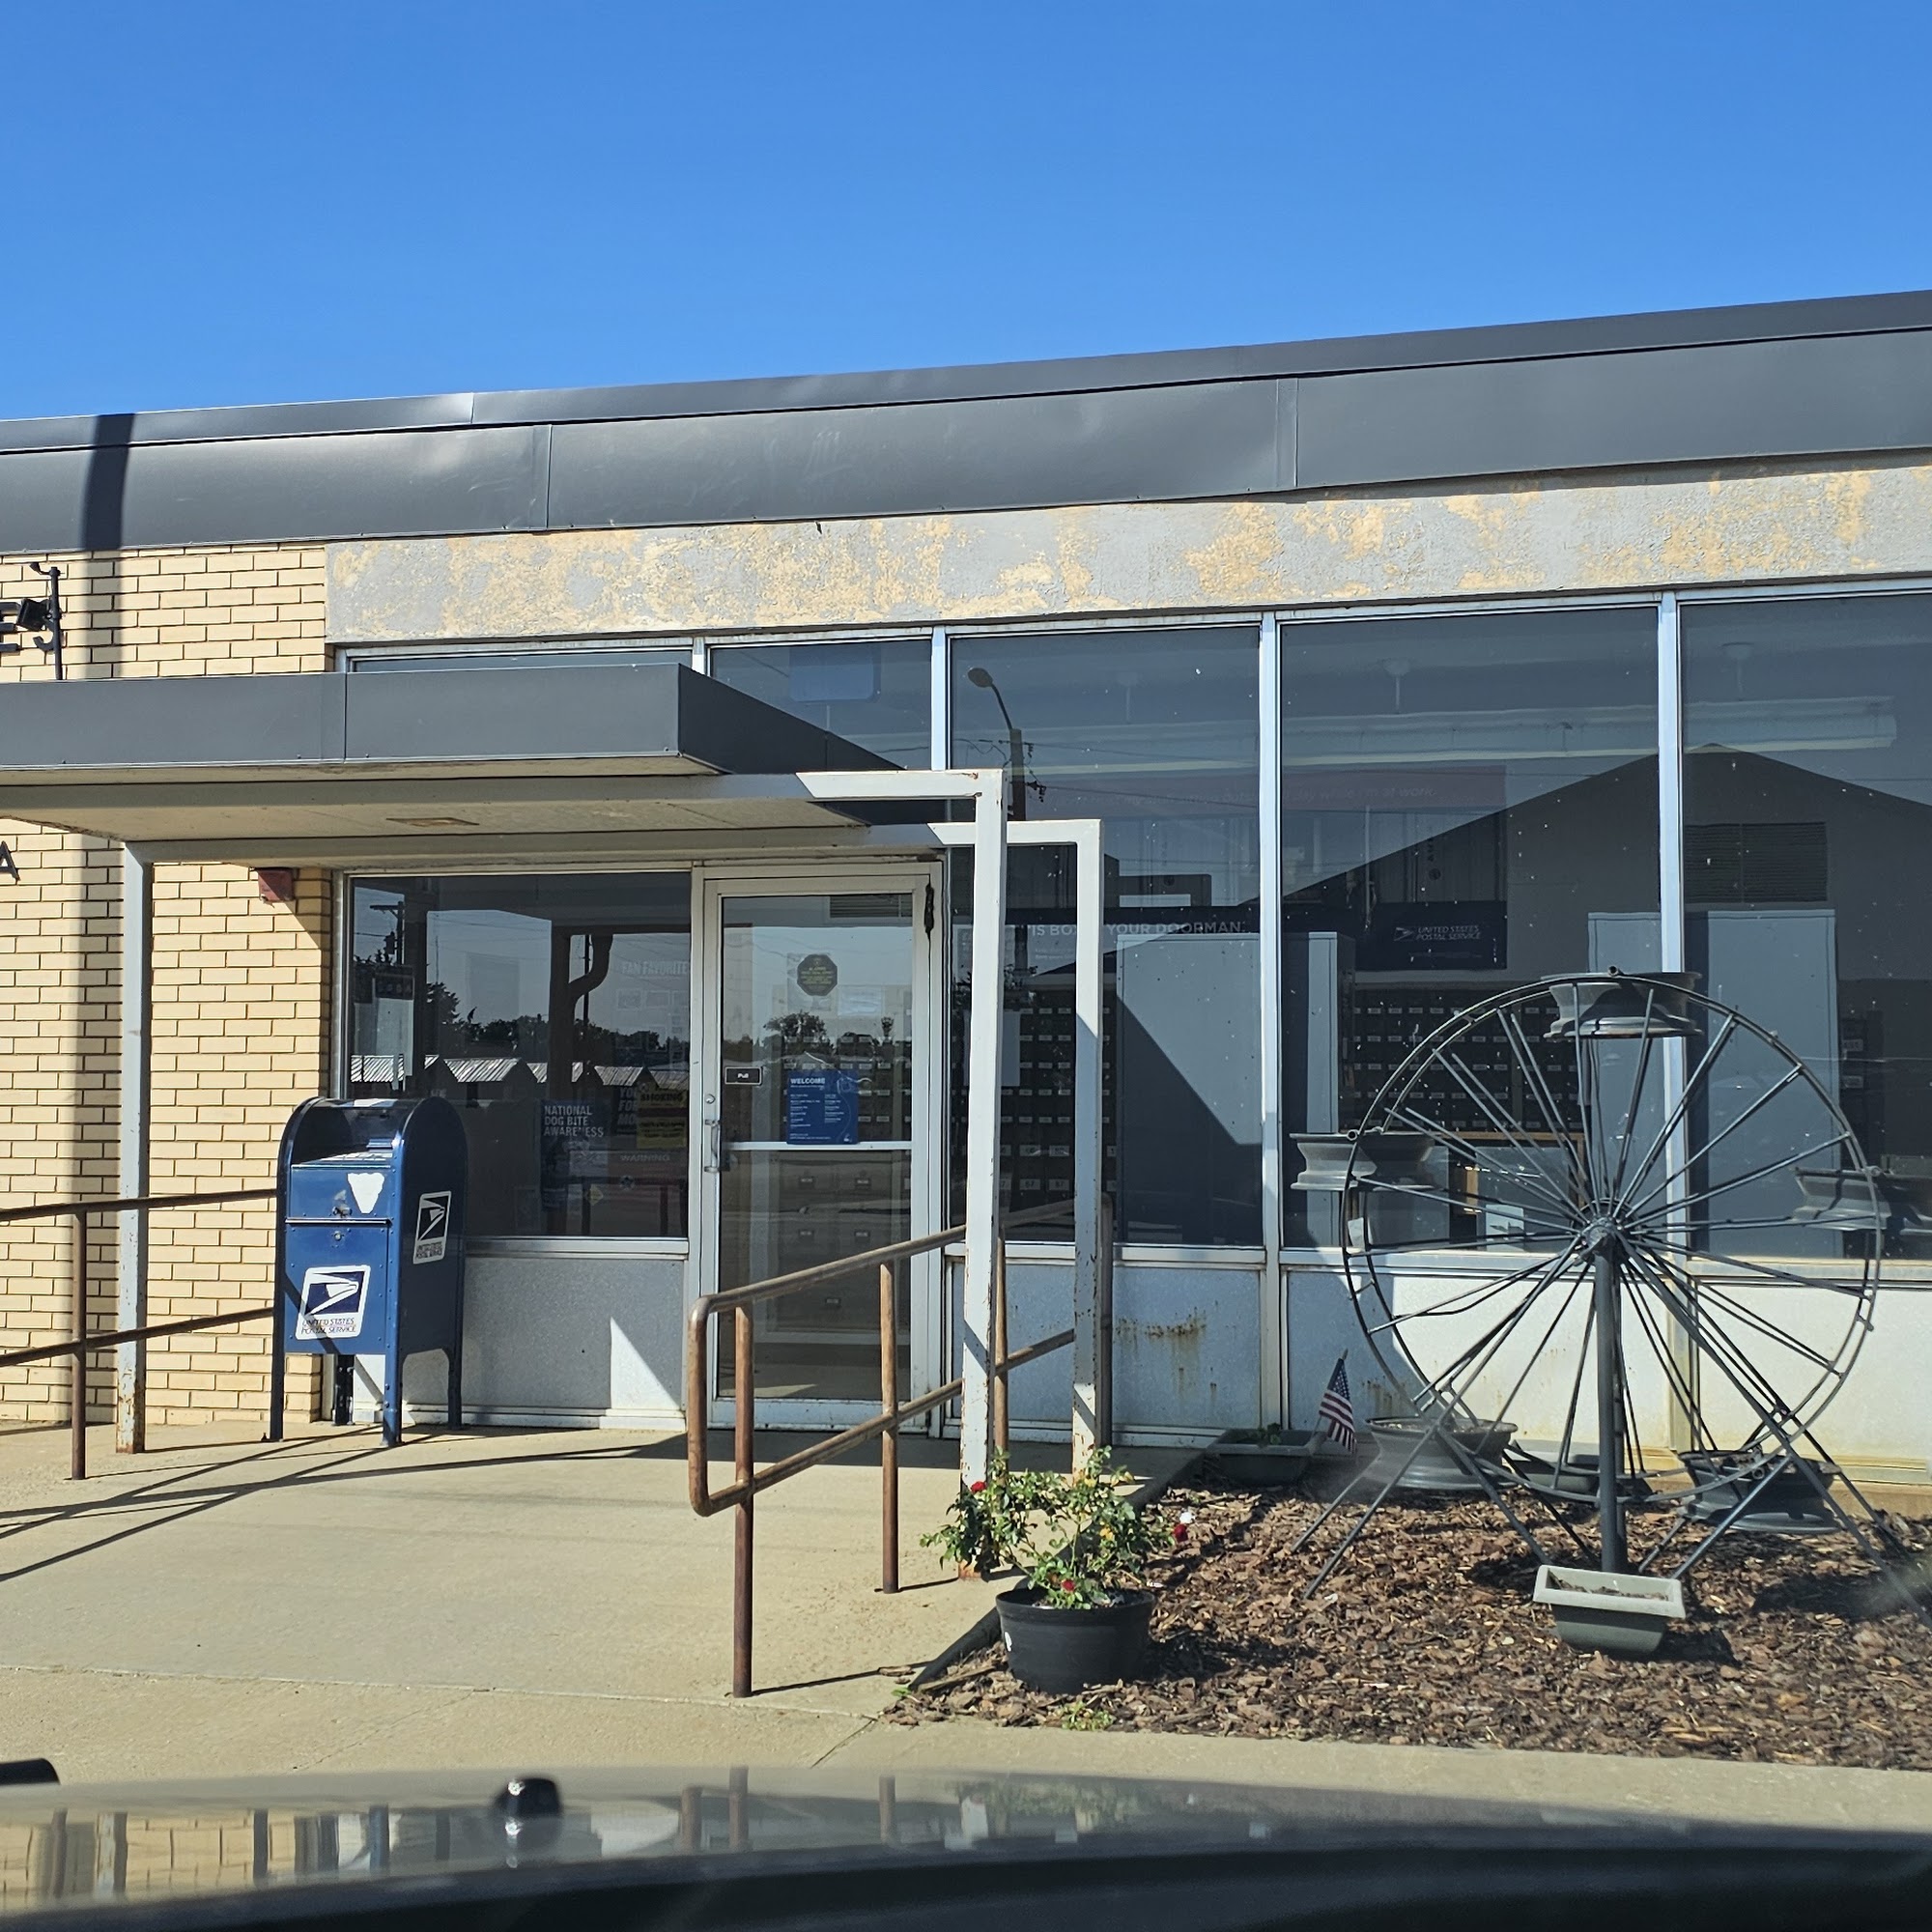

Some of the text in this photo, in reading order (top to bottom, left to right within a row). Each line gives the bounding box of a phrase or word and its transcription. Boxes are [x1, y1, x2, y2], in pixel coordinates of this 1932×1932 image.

[0, 840, 20, 881] A
[1107, 923, 1151, 935] YOUR
[544, 1105, 593, 1115] NATIONAL
[545, 1117, 588, 1125] DOG BITE
[328, 1324, 356, 1333] SERVICE
